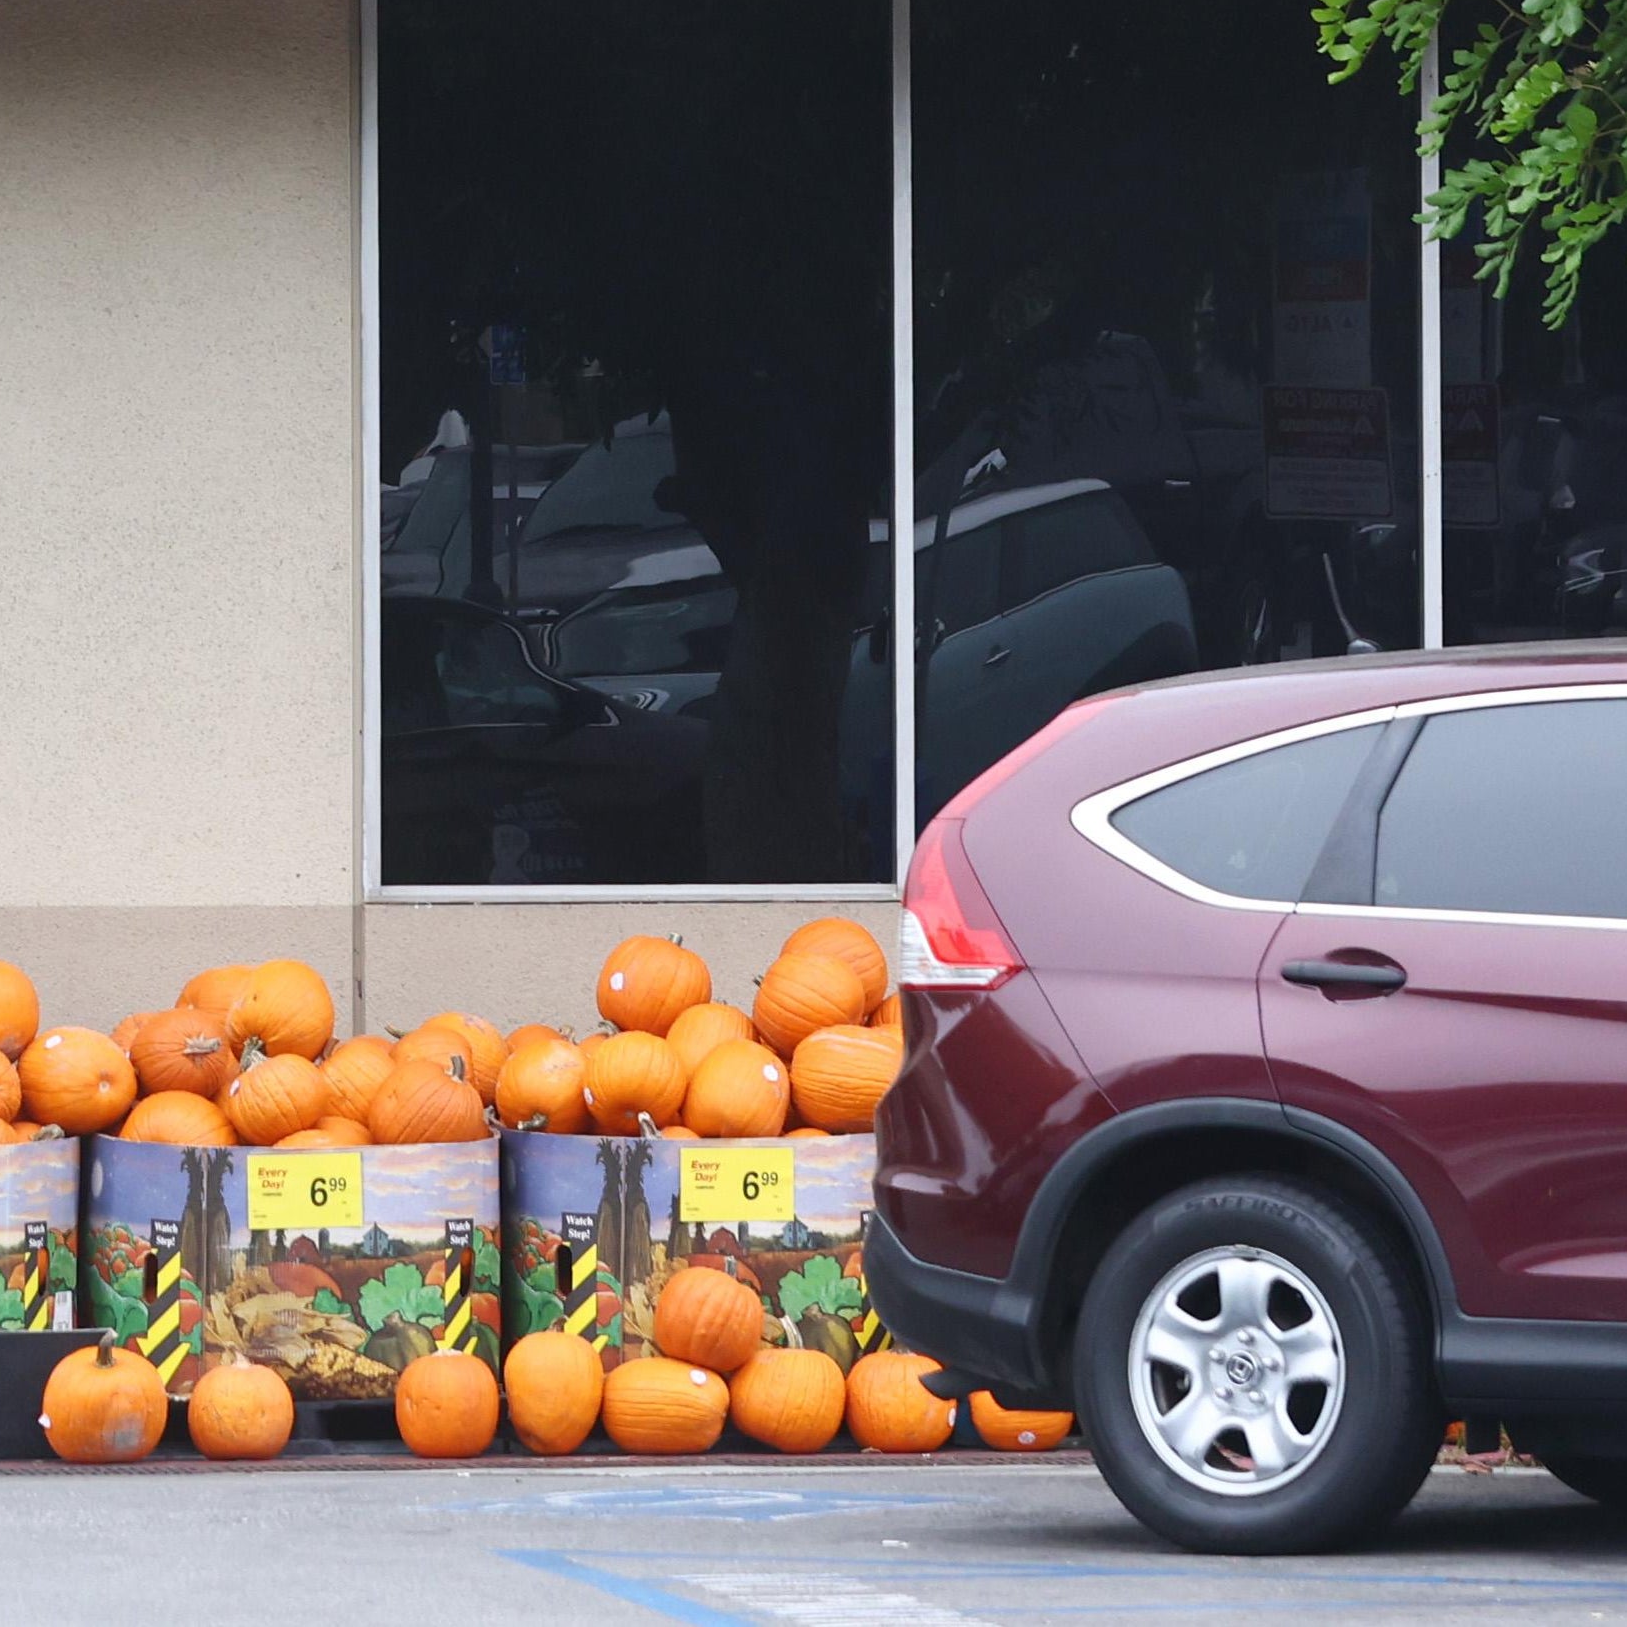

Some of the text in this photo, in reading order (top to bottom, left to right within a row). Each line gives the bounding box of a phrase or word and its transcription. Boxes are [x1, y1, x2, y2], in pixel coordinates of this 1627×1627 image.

[690, 1159, 721, 1171] Every
[258, 1166, 288, 1178] Every
[694, 1172, 718, 1183] Day!
[261, 1179, 285, 1190] Day!
[448, 1220, 472, 1232] Watch
[565, 1214, 594, 1227] Watch
[27, 1224, 46, 1234] Watch
[154, 1221, 179, 1234] Watch
[449, 1234, 469, 1247] Step!
[568, 1228, 591, 1242] Step!
[28, 1237, 44, 1249] Step!
[155, 1235, 176, 1249] Step!
